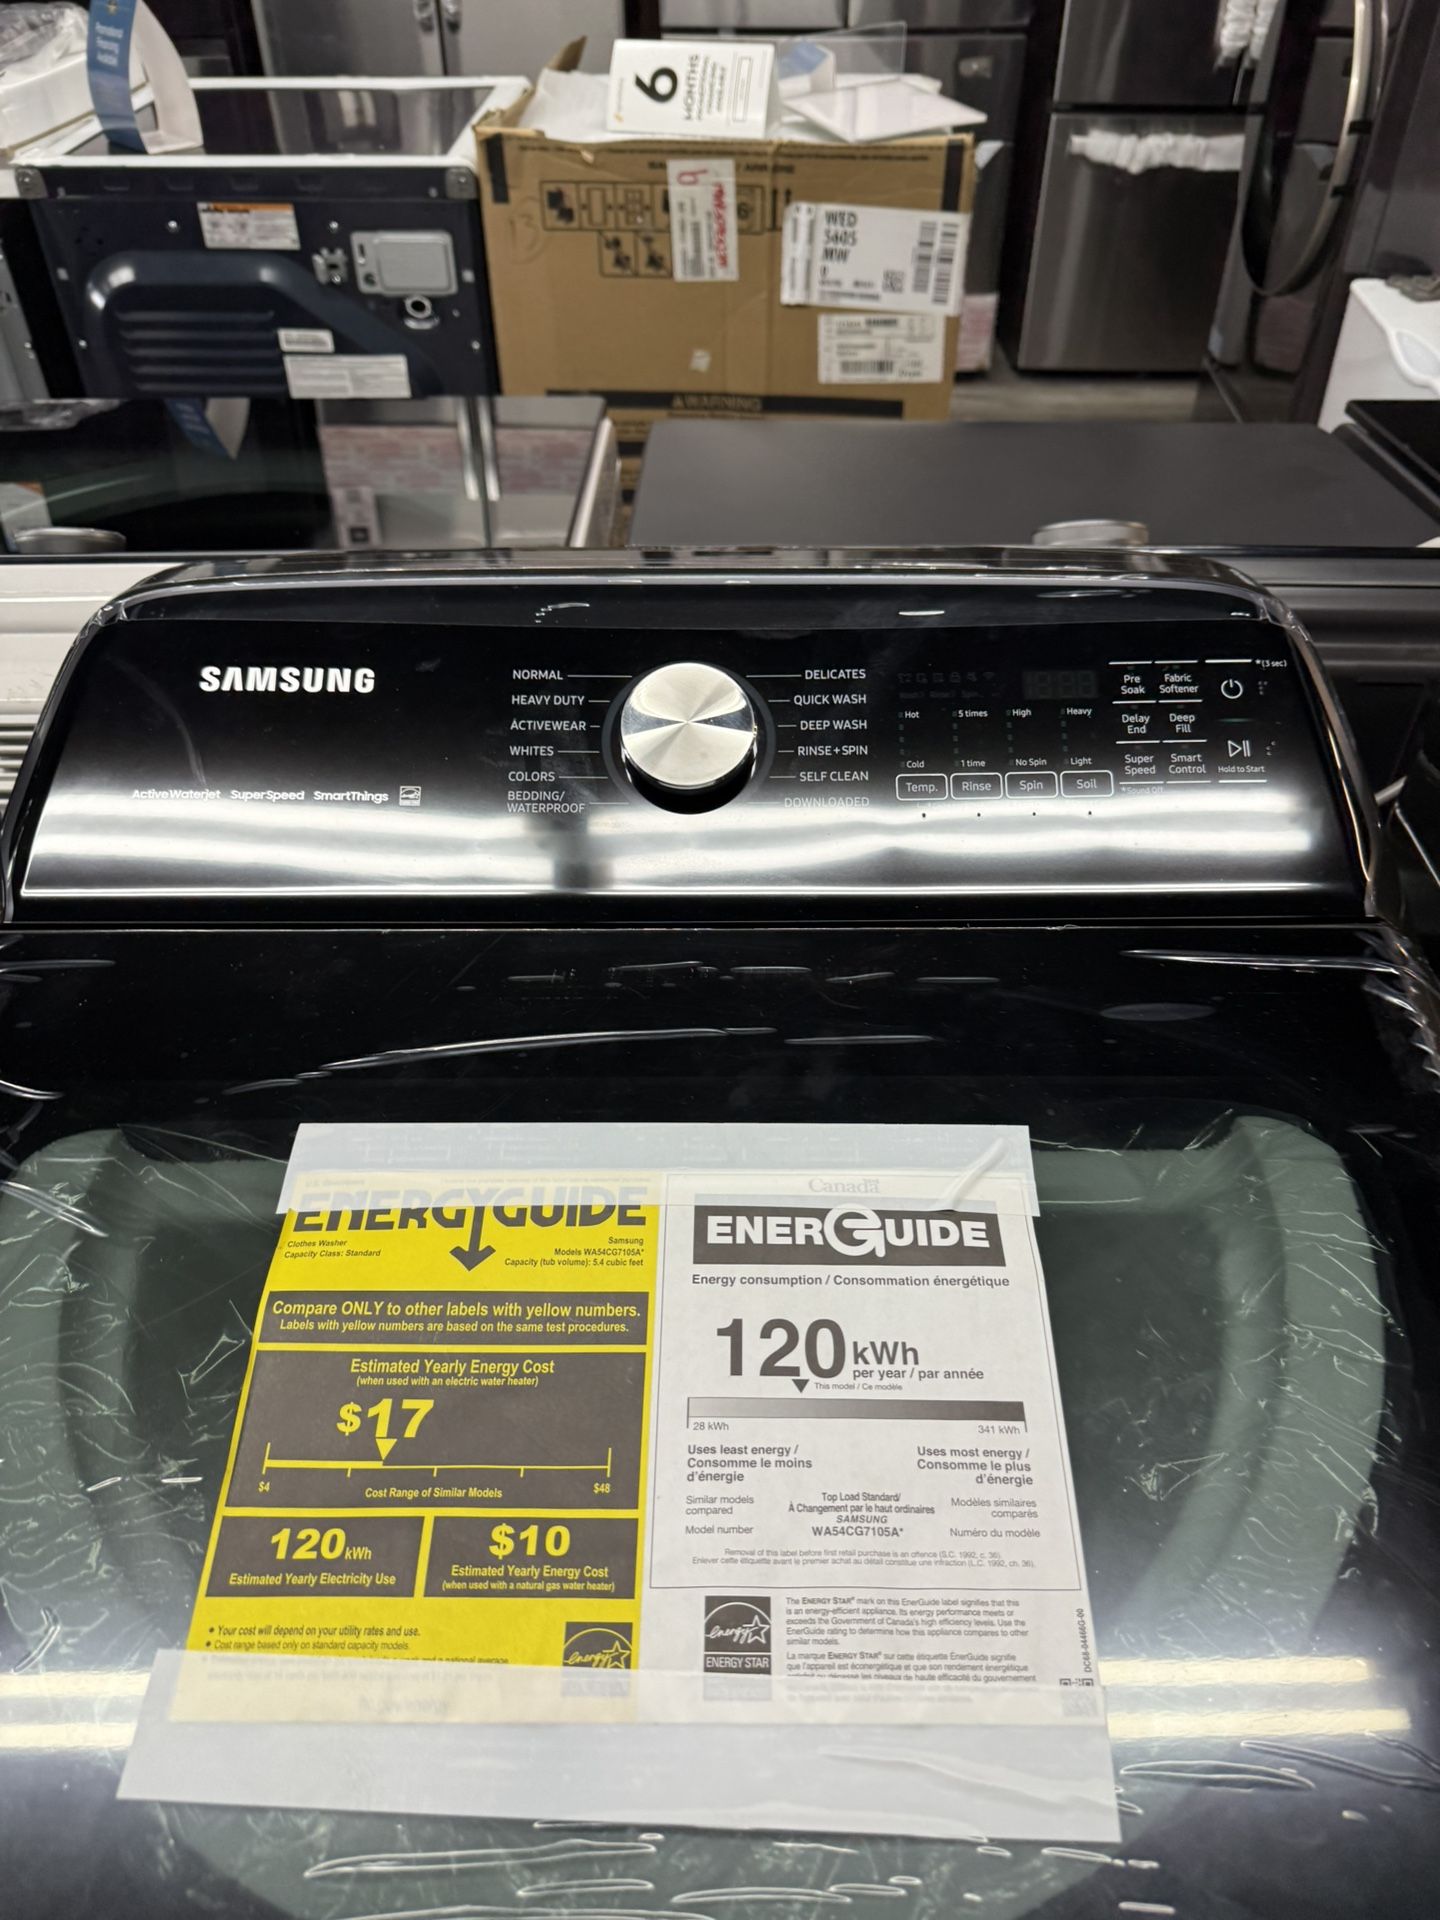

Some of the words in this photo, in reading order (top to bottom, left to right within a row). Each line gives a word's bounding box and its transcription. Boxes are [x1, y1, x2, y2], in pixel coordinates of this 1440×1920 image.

[635, 67, 677, 103] 6
[200, 666, 375, 693] SAMSUNG
[513, 669, 563, 680] NORMAL
[805, 669, 866, 680] DELICATES
[1124, 675, 1140, 683] Pre
[1164, 674, 1192, 682] Fabric
[1121, 686, 1145, 694] Soak
[1159, 685, 1198, 693] Softener
[512, 695, 551, 706] HEAVY
[554, 695, 584, 706] DUTY
[794, 695, 829, 705] QUICK
[832, 694, 866, 704] WASH
[1013, 709, 1031, 718] High
[1067, 708, 1092, 716] Heavy
[1122, 714, 1149, 725] Delay
[1170, 714, 1195, 724] Deep
[510, 721, 586, 731] ACTIVEWEAR
[800, 720, 828, 731] DEEP
[832, 720, 867, 730] WASH
[1128, 725, 1146, 734] End
[1176, 724, 1191, 733] Fill
[510, 746, 553, 756] WHITES
[798, 746, 868, 756] RINSE+SPIN
[1029, 758, 1047, 767] Spin
[1071, 757, 1092, 766] Light
[1125, 754, 1153, 764] Super
[1171, 754, 1202, 762] Smart
[907, 760, 924, 768] Cold
[1169, 765, 1206, 774] Control
[508, 771, 555, 782] COLORS
[800, 771, 827, 781] SELF
[830, 771, 869, 781] CLEAN
[1125, 766, 1155, 776] Speed
[906, 783, 938, 793] Temp.
[962, 782, 991, 791] Rinse
[1020, 781, 1043, 791] Spin
[1077, 779, 1097, 789] Soil
[132, 789, 221, 801] ActiveWaterjet
[231, 789, 305, 802] SuperSpeed
[314, 790, 388, 803] SmartThings
[508, 791, 565, 802] BEDDING/
[507, 802, 584, 813] WATERPROOF
[785, 797, 869, 808] DOWNLOADED
[707, 1203, 990, 1257] ENERGUIDE
[287, 1240, 317, 1248] Clothes
[318, 1239, 347, 1247] Washer
[608, 1236, 644, 1246] Samsung
[284, 1250, 317, 1260] Capacity
[319, 1249, 343, 1259] Class:
[346, 1248, 381, 1258] Standard
[554, 1247, 582, 1256] Models
[505, 1257, 541, 1268] Capacity
[540, 1257, 556, 1267] (tub
[558, 1257, 590, 1268] volume):
[592, 1258, 604, 1266] 5.4
[606, 1258, 626, 1267] cubic
[627, 1258, 643, 1267] feet
[692, 1274, 736, 1287] Energy
[740, 1275, 822, 1287] consumption
[825, 1274, 831, 1285] /
[833, 1275, 929, 1287] Consommation
[933, 1275, 1010, 1288] énergétique
[272, 1301, 337, 1318] Compare
[342, 1301, 383, 1316] ONLY
[387, 1303, 402, 1317] to
[405, 1302, 443, 1317] other
[446, 1301, 488, 1317] labels
[493, 1302, 522, 1317] with
[526, 1302, 571, 1320] yellow
[575, 1302, 641, 1318] numbers.
[717, 1318, 846, 1378] 120
[853, 1341, 919, 1365] kWh
[351, 1359, 420, 1374] Estimated
[423, 1359, 467, 1376] Yearly
[470, 1360, 519, 1377] Energy
[522, 1360, 554, 1374] Cost
[853, 1370, 873, 1381] per
[878, 1369, 907, 1381] year
[918, 1369, 940, 1381] par
[943, 1368, 984, 1380] année
[336, 1398, 435, 1438] $17
[692, 1422, 705, 1431] 28
[707, 1421, 729, 1431] kWh
[978, 1425, 996, 1435] 341
[998, 1425, 1020, 1435] kWh
[688, 1445, 716, 1455] Uses
[719, 1445, 748, 1455] least
[751, 1445, 791, 1457] energy
[917, 1446, 946, 1457] Uses
[950, 1448, 978, 1458] most
[982, 1449, 1022, 1460] energy
[687, 1458, 757, 1468] Consomme
[760, 1457, 770, 1468] le
[775, 1458, 812, 1468] moins
[917, 1459, 986, 1471] Consomme
[990, 1460, 1001, 1471] le
[1004, 1461, 1031, 1474] plus
[687, 1471, 744, 1483] d'énergie
[976, 1474, 1033, 1487] d'énergie
[258, 1480, 270, 1494] $4
[593, 1482, 610, 1495] $48
[365, 1488, 387, 1498] Cost
[389, 1488, 417, 1499] Range
[419, 1487, 432, 1498] of
[433, 1487, 465, 1498] Similar
[468, 1487, 502, 1498] Models
[836, 1514, 888, 1524] SAMSUNG
[270, 1528, 346, 1560] 120
[345, 1545, 372, 1561] kWh
[489, 1522, 570, 1560] $10
[229, 1573, 283, 1585] Estimated
[285, 1572, 318, 1587] Yearly
[319, 1572, 372, 1587] Electricity
[375, 1573, 396, 1585] Use
[217, 1625, 236, 1636] Your
[238, 1626, 255, 1636] cost
[258, 1625, 272, 1635] will
[273, 1625, 304, 1638] depend
[306, 1627, 316, 1635] on
[318, 1627, 337, 1637] your
[340, 1625, 361, 1638] utility
[364, 1626, 384, 1636] rates
[385, 1626, 402, 1636] and
[404, 1627, 420, 1636] use.
[706, 1657, 743, 1668] ENERGY
[744, 1657, 769, 1668] STAR
